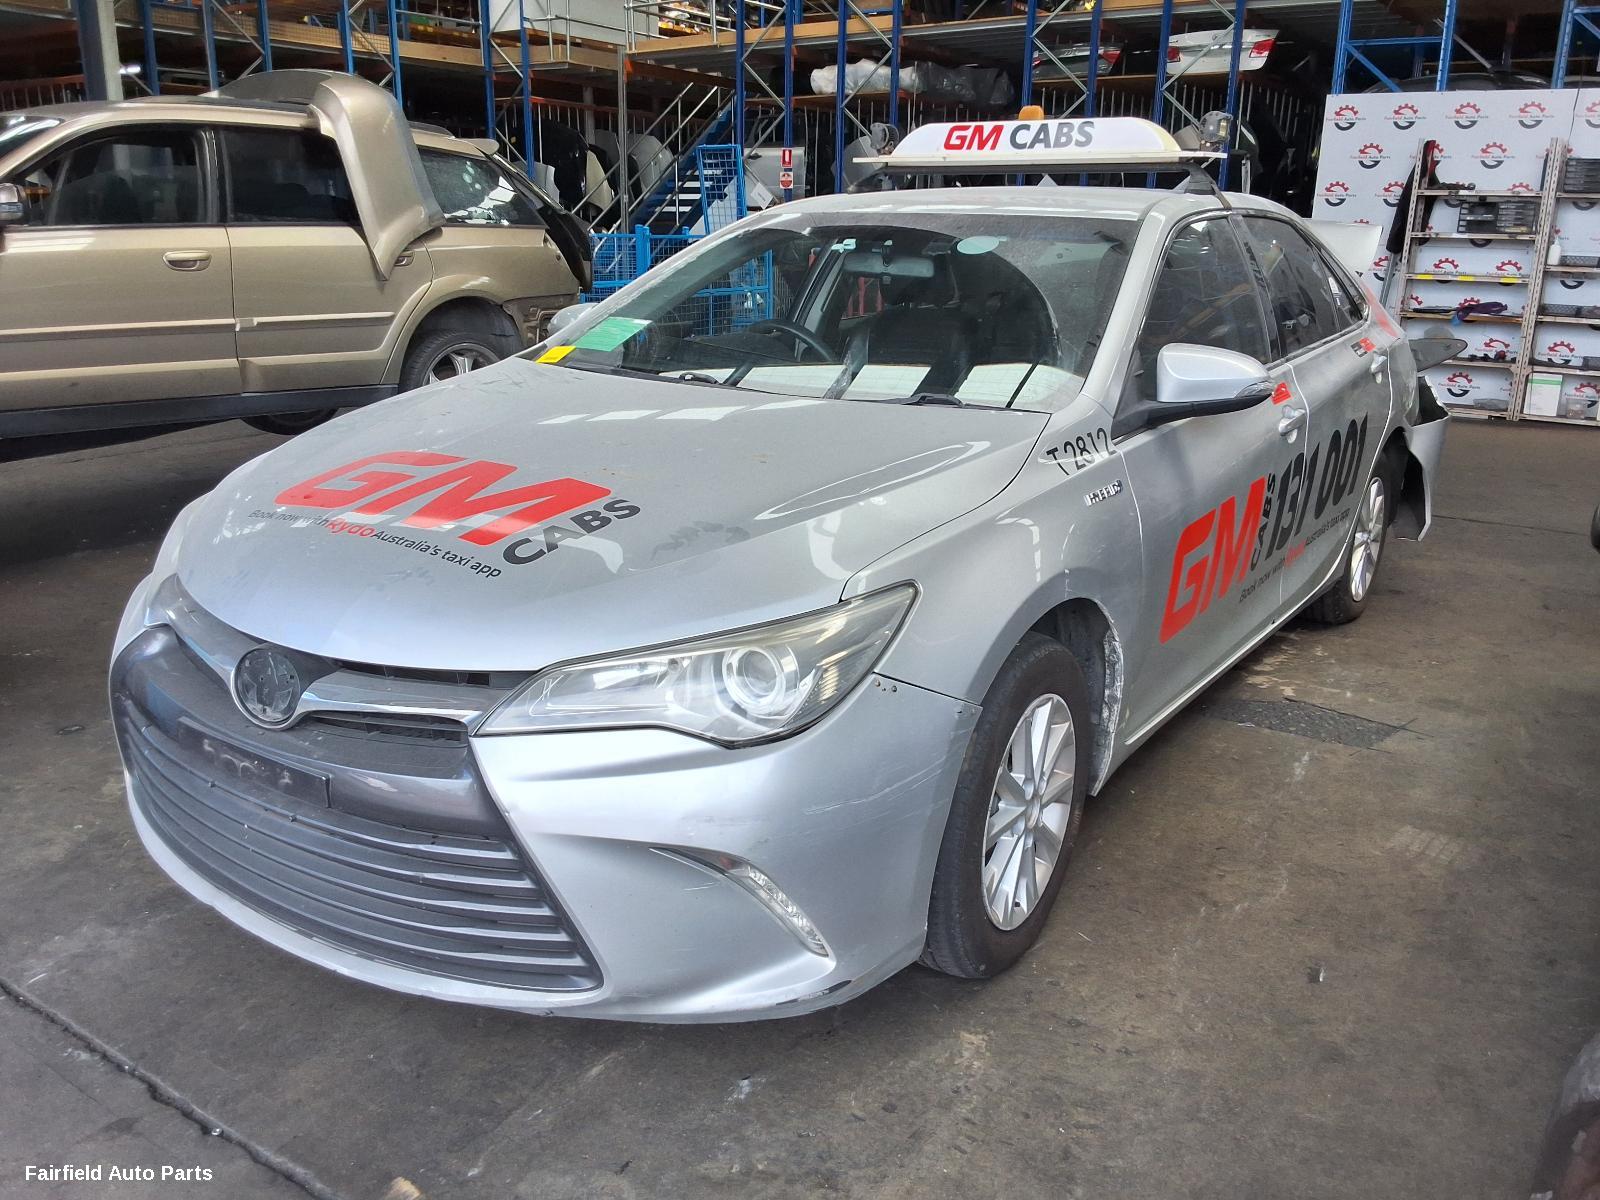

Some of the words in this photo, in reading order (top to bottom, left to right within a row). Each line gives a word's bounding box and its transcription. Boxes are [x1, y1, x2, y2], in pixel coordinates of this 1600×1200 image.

[943, 124, 1004, 150] GM
[1009, 120, 1095, 150] CABS
[1046, 446, 1070, 476] T
[1063, 427, 1118, 471] 2812
[1314, 411, 1369, 520] 001
[274, 451, 612, 546] GM
[502, 498, 642, 566] CABS
[372, 530, 441, 556] Australia's
[441, 549, 472, 568] taxi
[469, 560, 502, 579] app
[1158, 475, 1267, 646] GM
